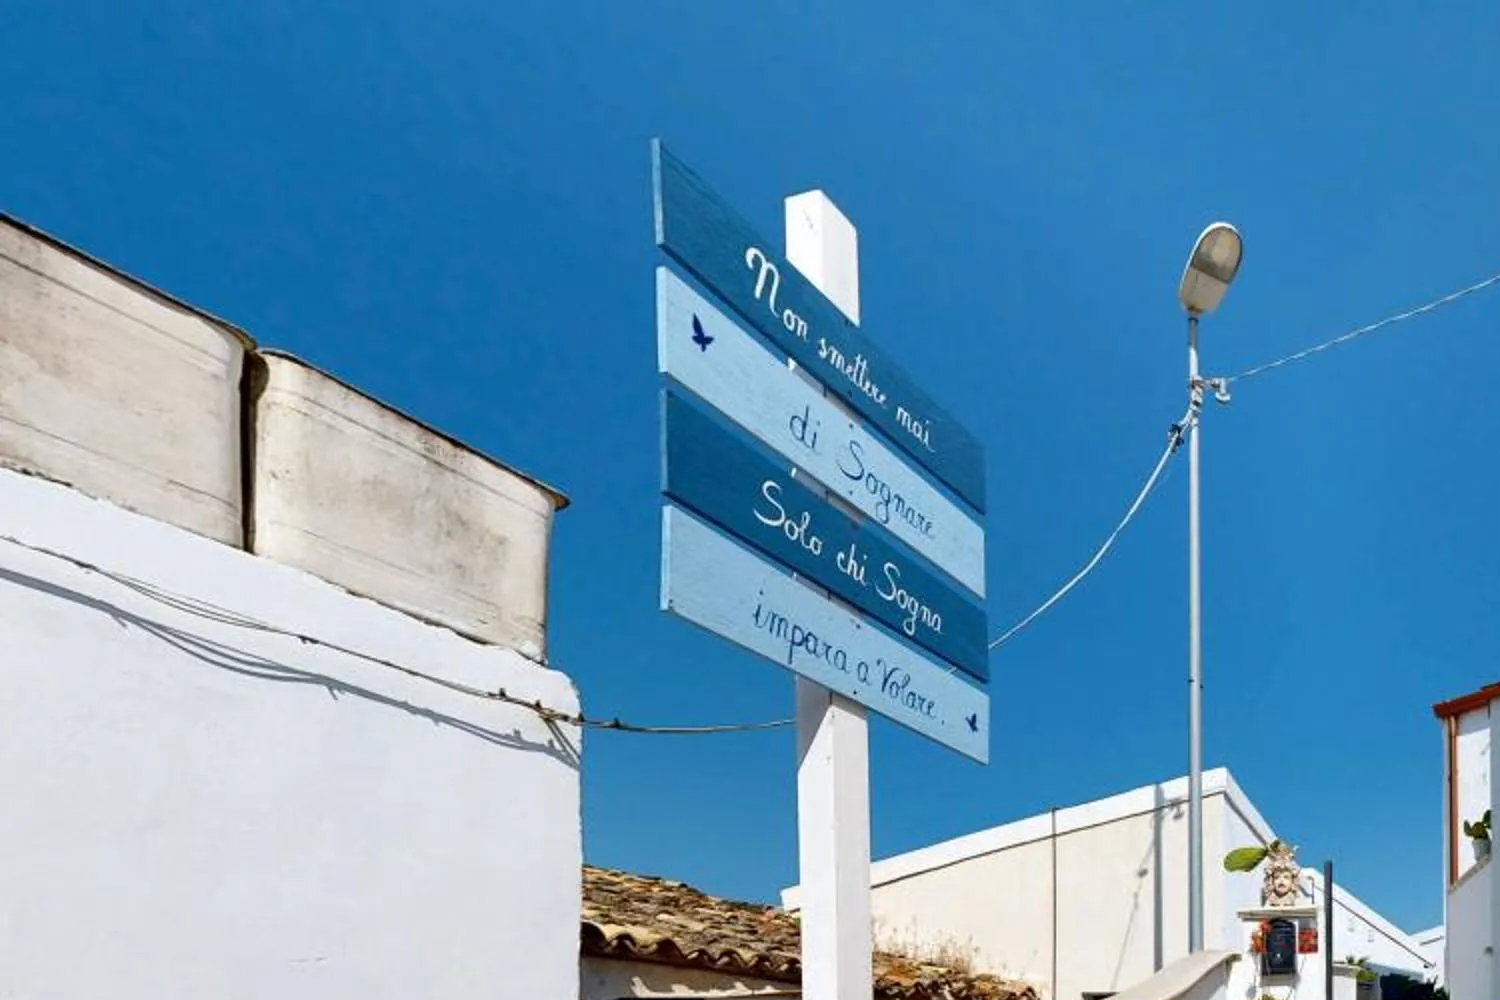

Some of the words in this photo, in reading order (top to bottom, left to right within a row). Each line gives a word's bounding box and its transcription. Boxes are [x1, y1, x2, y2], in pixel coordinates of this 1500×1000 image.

[745, 246, 809, 341] Non
[817, 338, 888, 408] smettere
[895, 406, 936, 452] mai
[789, 404, 822, 449] di
[836, 440, 935, 536] Sognare
[753, 480, 823, 556] Solo
[836, 543, 868, 586] chi
[875, 562, 943, 636] Sogna
[752, 589, 850, 675] impara
[857, 660, 872, 687] a
